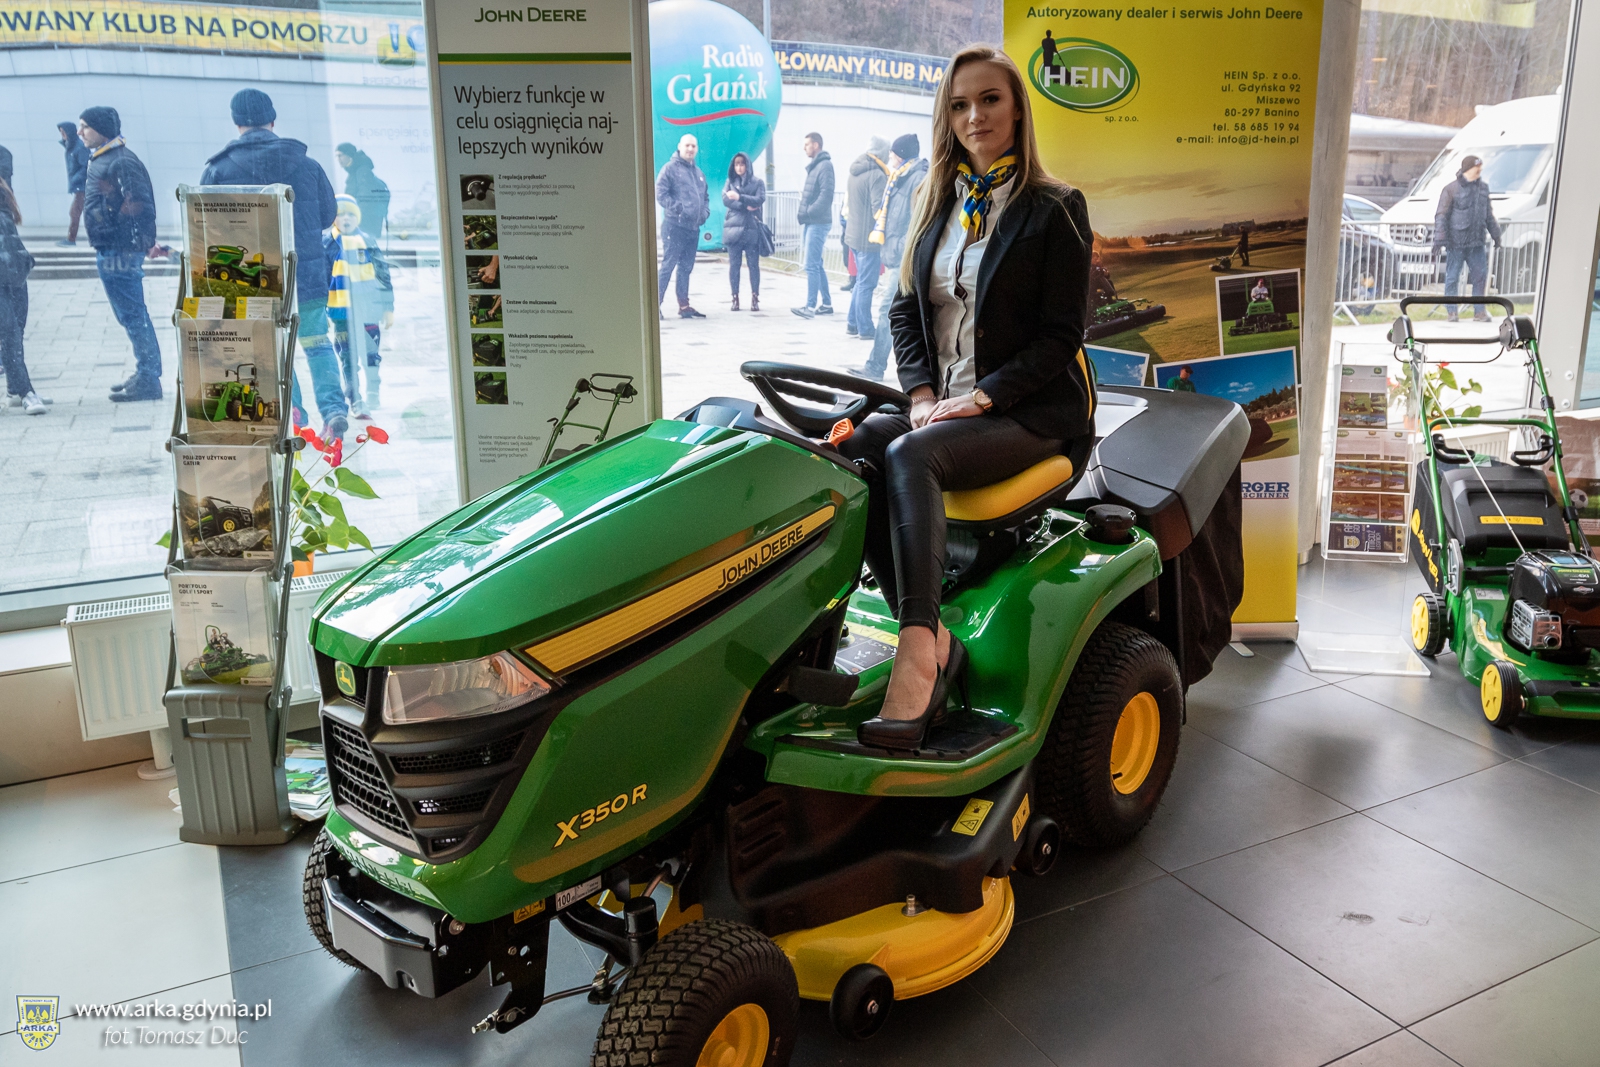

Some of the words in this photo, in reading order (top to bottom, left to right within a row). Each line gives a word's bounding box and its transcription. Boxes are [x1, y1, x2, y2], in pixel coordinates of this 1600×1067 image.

[474, 7, 523, 22] JOHN
[527, 7, 587, 22] DEERE
[1026, 7, 1123, 21] Autoryzowany
[1127, 7, 1168, 19] dealer
[1172, 7, 1176, 19] i
[1180, 7, 1223, 19] serwis
[1227, 7, 1261, 19] John
[1265, 7, 1303, 20] Deere
[0, 11, 94, 31] WANY
[103, 12, 177, 35] KLUB
[186, 17, 225, 37] NA
[232, 19, 368, 45] POMORZU
[701, 44, 764, 68] Radio
[868, 58, 915, 80] KLUB
[919, 64, 943, 83] NA
[1044, 66, 1125, 88] HEIN
[1224, 71, 1248, 80] HEIN
[1252, 71, 1268, 81] Sp.
[666, 69, 768, 105] Gdańsk
[1221, 84, 1234, 92] ul.
[1238, 83, 1285, 94] Gdyńska
[1289, 84, 1301, 92] 92
[454, 85, 521, 109] Wybierz
[526, 84, 585, 108] funkcje
[590, 90, 605, 103] w
[1256, 96, 1300, 104] Miszewo
[1224, 108, 1260, 117] 80-297
[1264, 108, 1300, 117] Banino
[456, 110, 489, 129] celu
[494, 112, 583, 134] osiągnięcia
[588, 112, 619, 134] naj-
[1213, 123, 1229, 131] tel.
[1234, 123, 1246, 131] 58
[1250, 123, 1268, 131] 685
[1274, 123, 1285, 131] 19
[1288, 123, 1299, 131] 94
[458, 136, 526, 160] lepszych
[531, 137, 604, 160] wyników
[1176, 135, 1214, 144] e-mail:
[1218, 135, 1299, 145] info@jd-hein.pl
[1241, 482, 1290, 492] RGER
[718, 553, 759, 590] JOHN
[760, 525, 804, 564] DEERE
